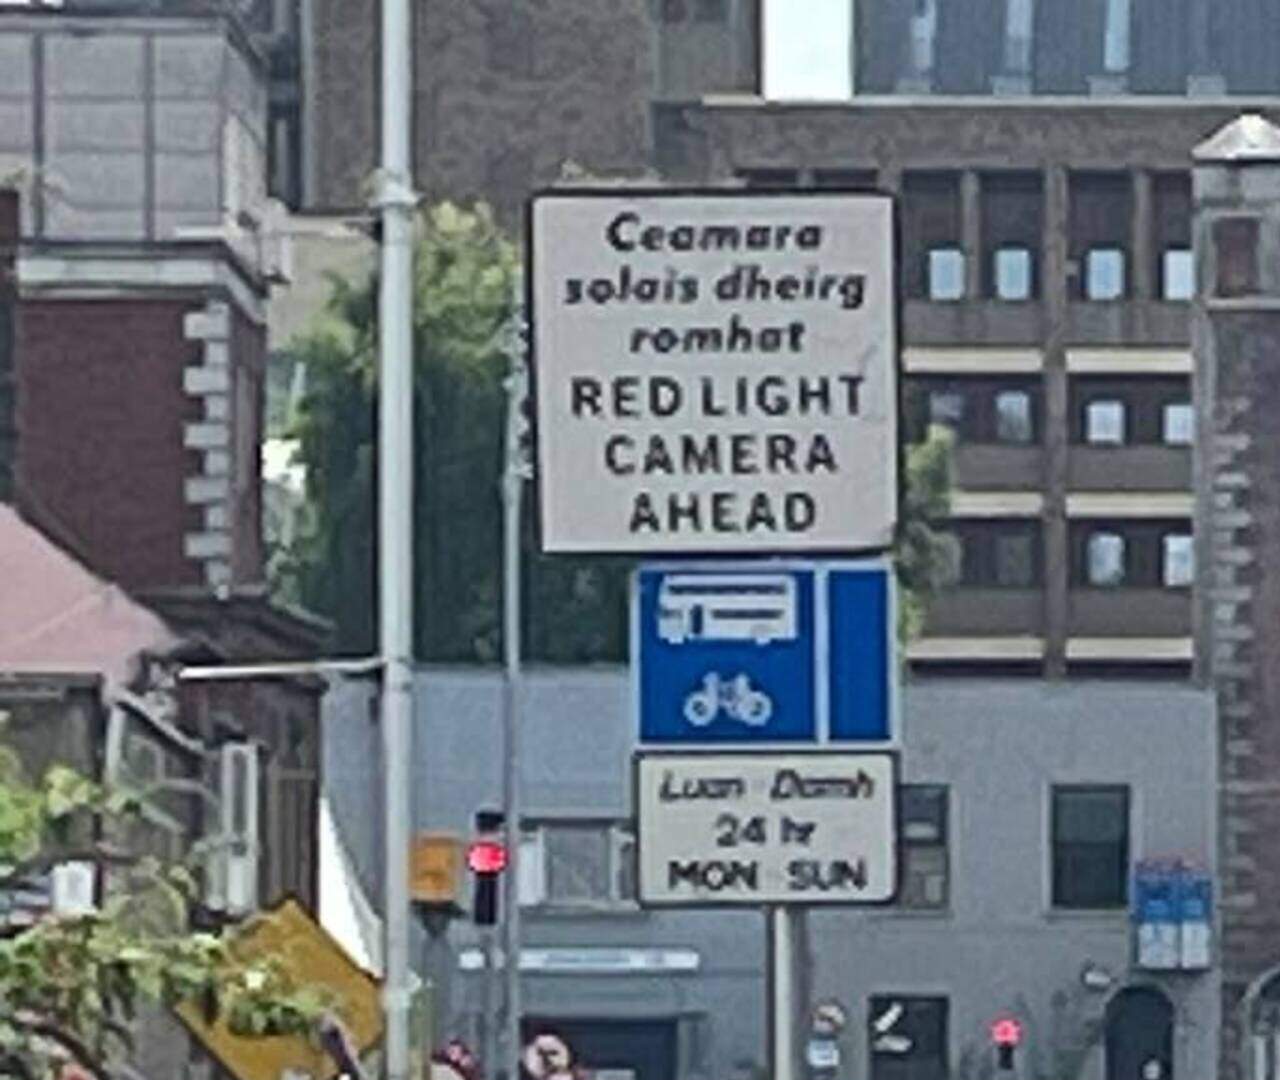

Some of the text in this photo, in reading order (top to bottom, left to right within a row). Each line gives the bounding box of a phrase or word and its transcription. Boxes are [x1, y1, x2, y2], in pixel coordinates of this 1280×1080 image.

[606, 212, 822, 252] Ceamara
[565, 263, 867, 310] solais dheirg
[630, 314, 806, 353] romhat
[570, 375, 866, 417] RED LIGHT
[605, 434, 838, 476] CAMERA
[629, 492, 817, 534] AHEAD
[716, 815, 816, 848] 24 hr
[667, 859, 869, 891] MON SUN
